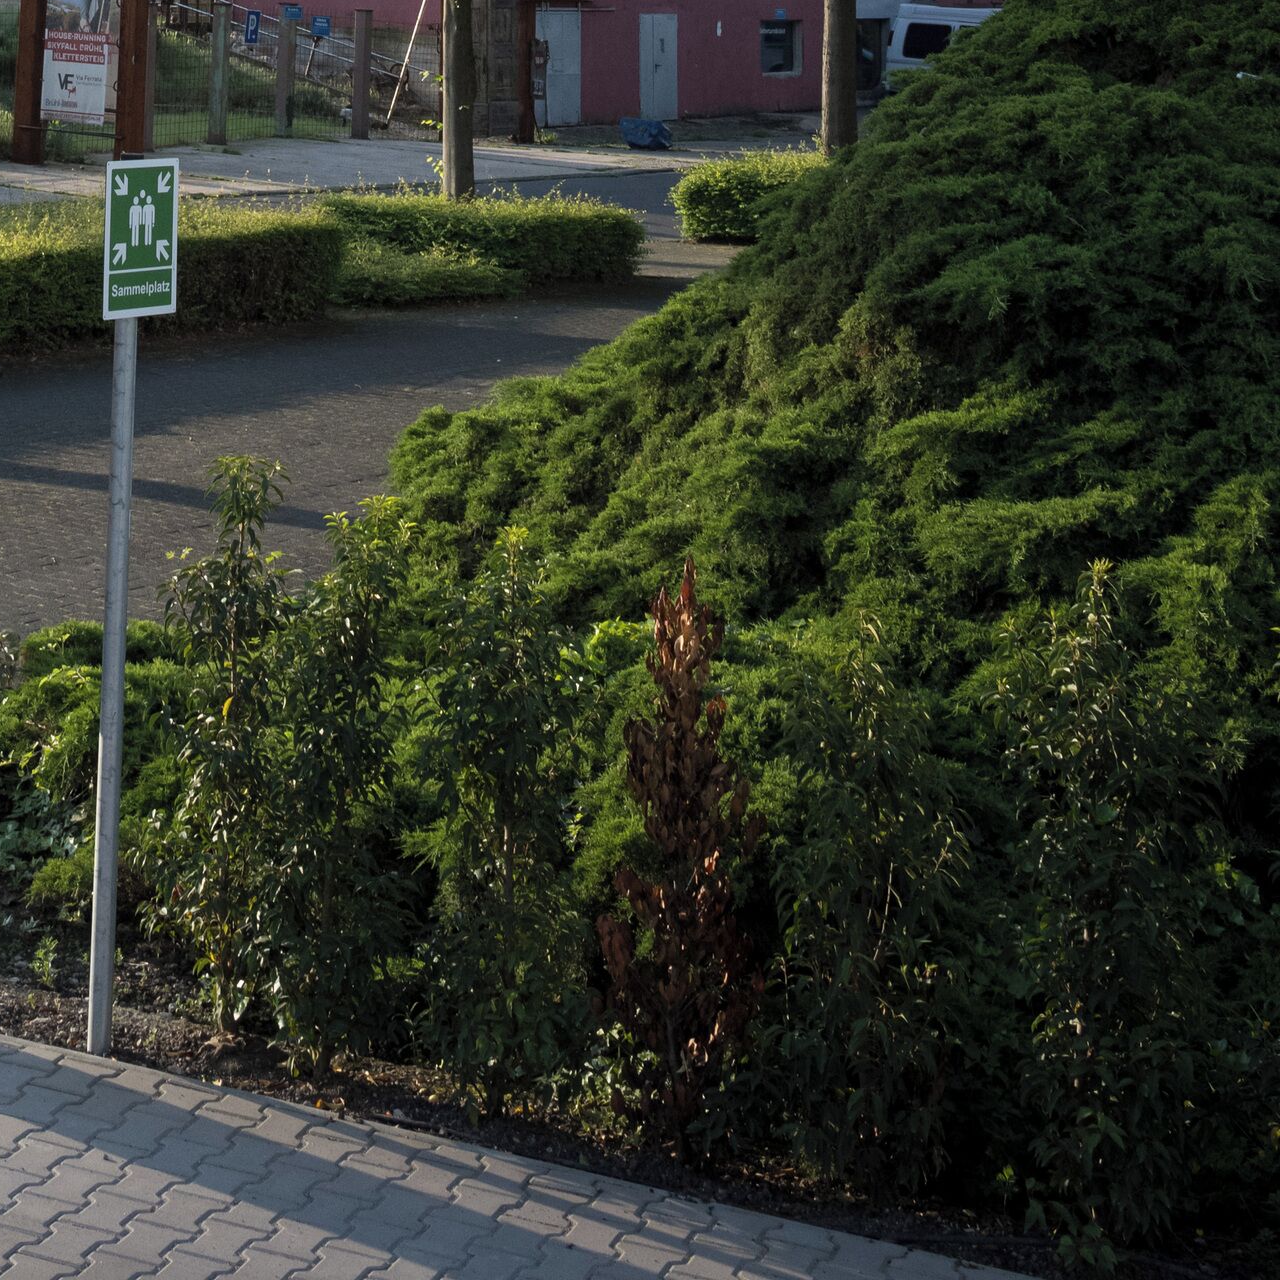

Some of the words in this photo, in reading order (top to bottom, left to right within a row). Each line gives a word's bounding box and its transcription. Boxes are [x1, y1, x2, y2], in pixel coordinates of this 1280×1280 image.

[247, 14, 257, 39] P
[47, 41, 77, 51] SKYFALL
[79, 43, 103, 53] BRÜHL
[53, 52, 104, 63] KLETTERSTEIG
[111, 280, 170, 298] Sammelplatz
